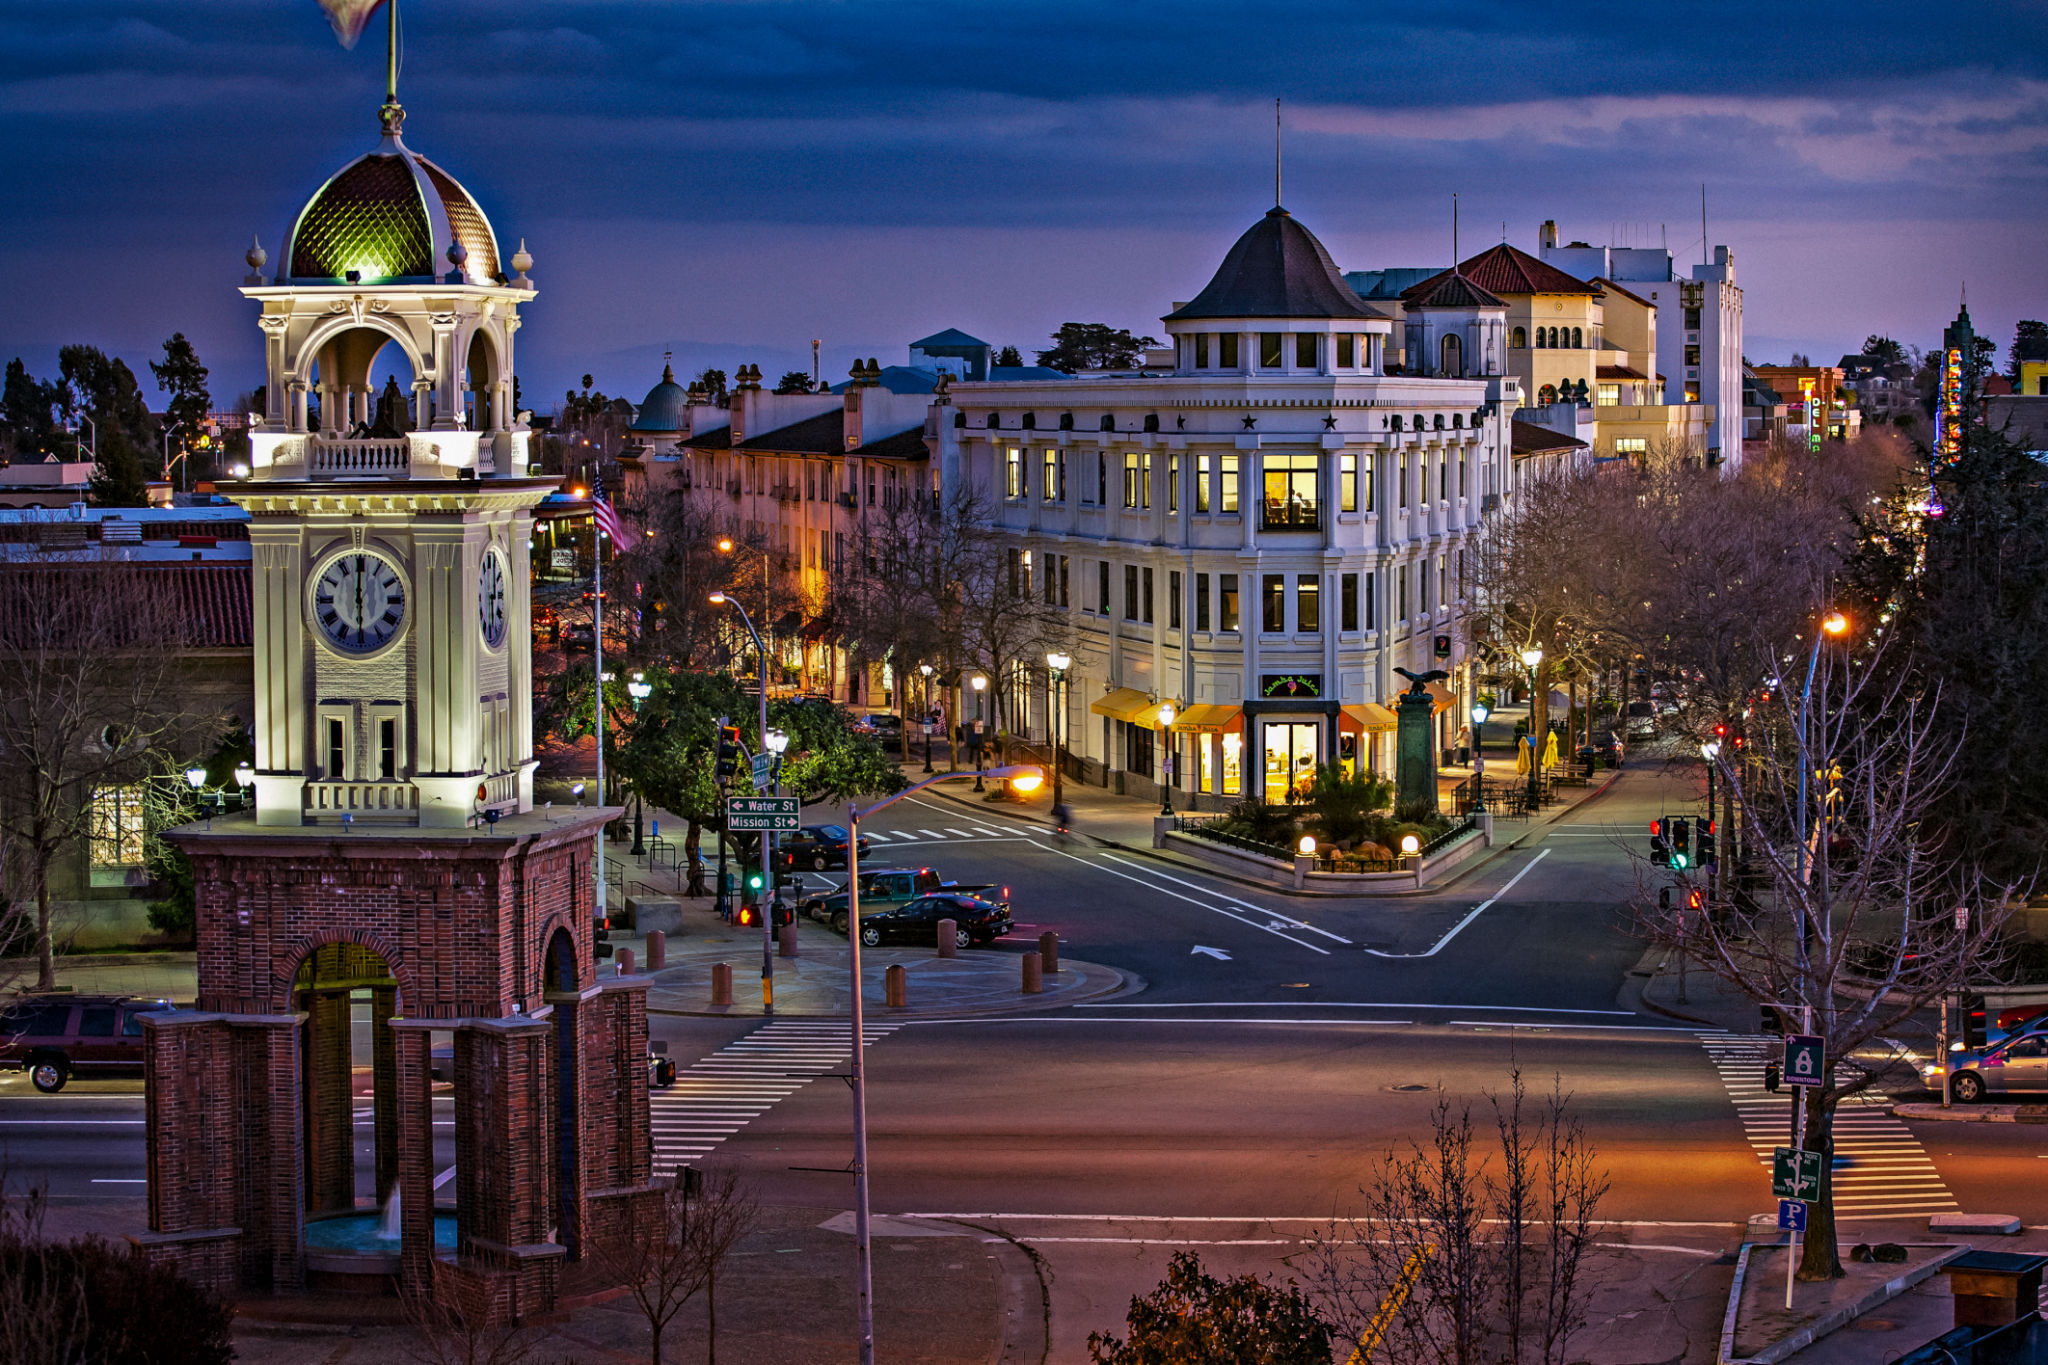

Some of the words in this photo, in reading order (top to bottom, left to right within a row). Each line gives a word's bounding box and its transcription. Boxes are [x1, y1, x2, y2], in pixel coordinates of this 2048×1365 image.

[1812, 397, 1821, 428] DEL
[1264, 676, 1293, 696] Jamba
[1297, 675, 1319, 695] Juice
[748, 801, 777, 811] Water
[782, 801, 794, 811] St
[731, 816, 770, 827] Mission
[774, 816, 786, 827] St
[1786, 1075, 1821, 1085] DOWNTOWN
[1786, 1203, 1802, 1219] P
